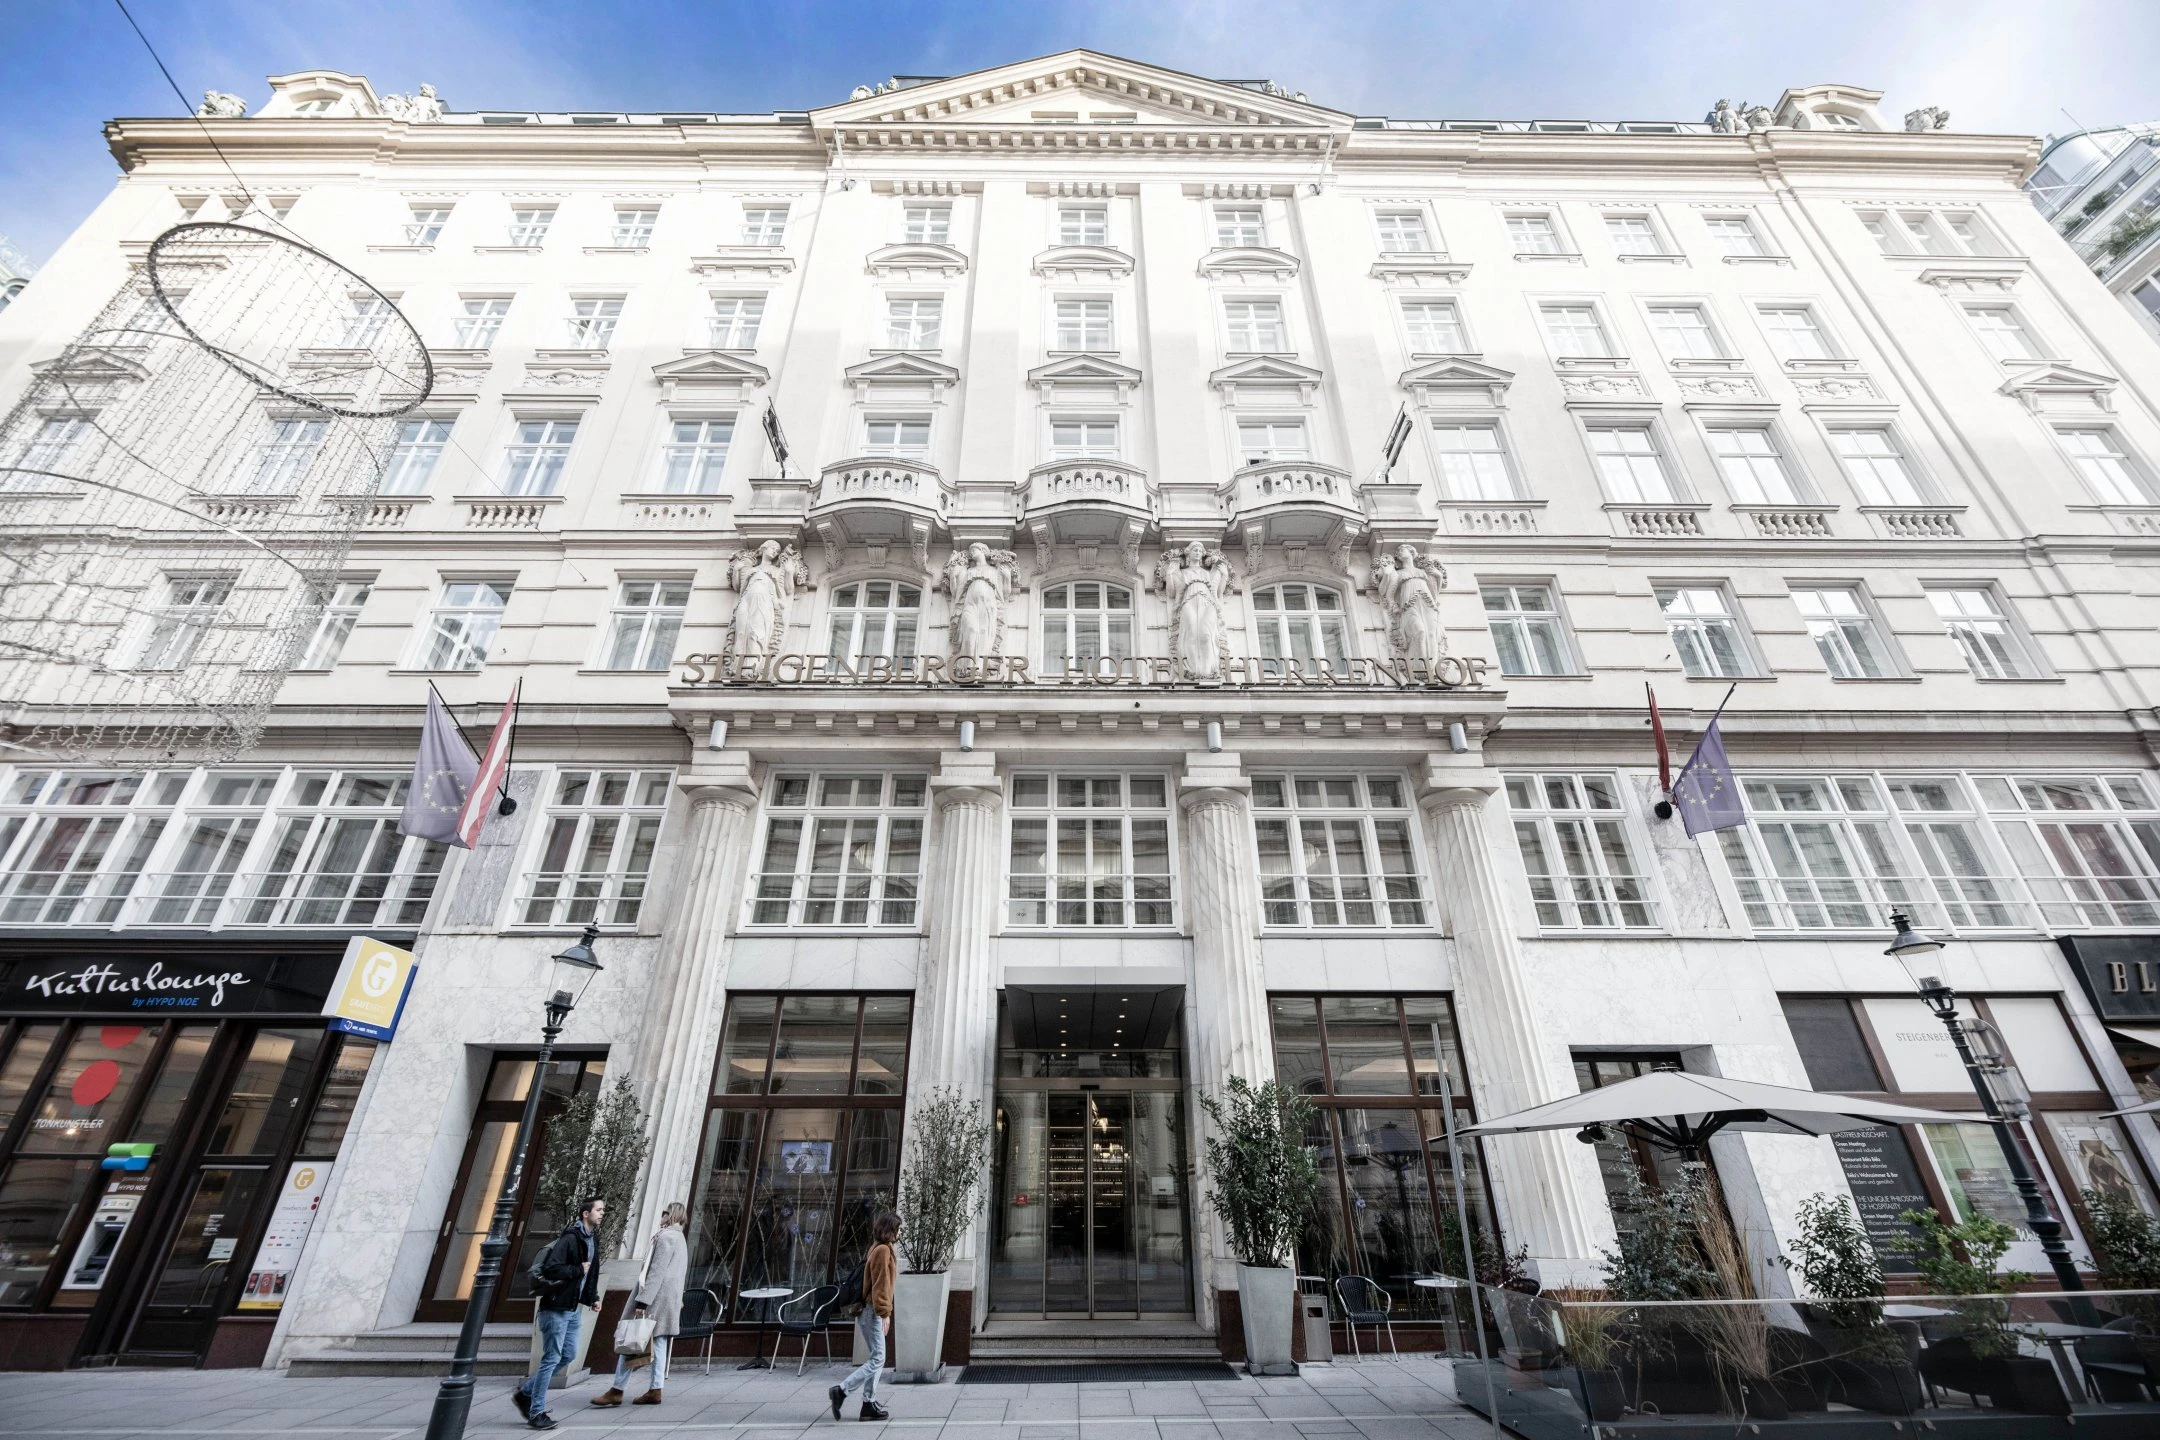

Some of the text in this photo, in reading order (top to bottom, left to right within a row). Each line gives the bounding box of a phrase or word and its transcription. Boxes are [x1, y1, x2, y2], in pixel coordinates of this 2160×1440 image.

[681, 652, 1491, 687] STEIGENBERGER HOTEL HERRENHOF
[25, 962, 250, 1007] Kulturlounge
[132, 997, 200, 1007] by HYPO NOE
[1896, 1032, 1952, 1042] STEIGENBER
